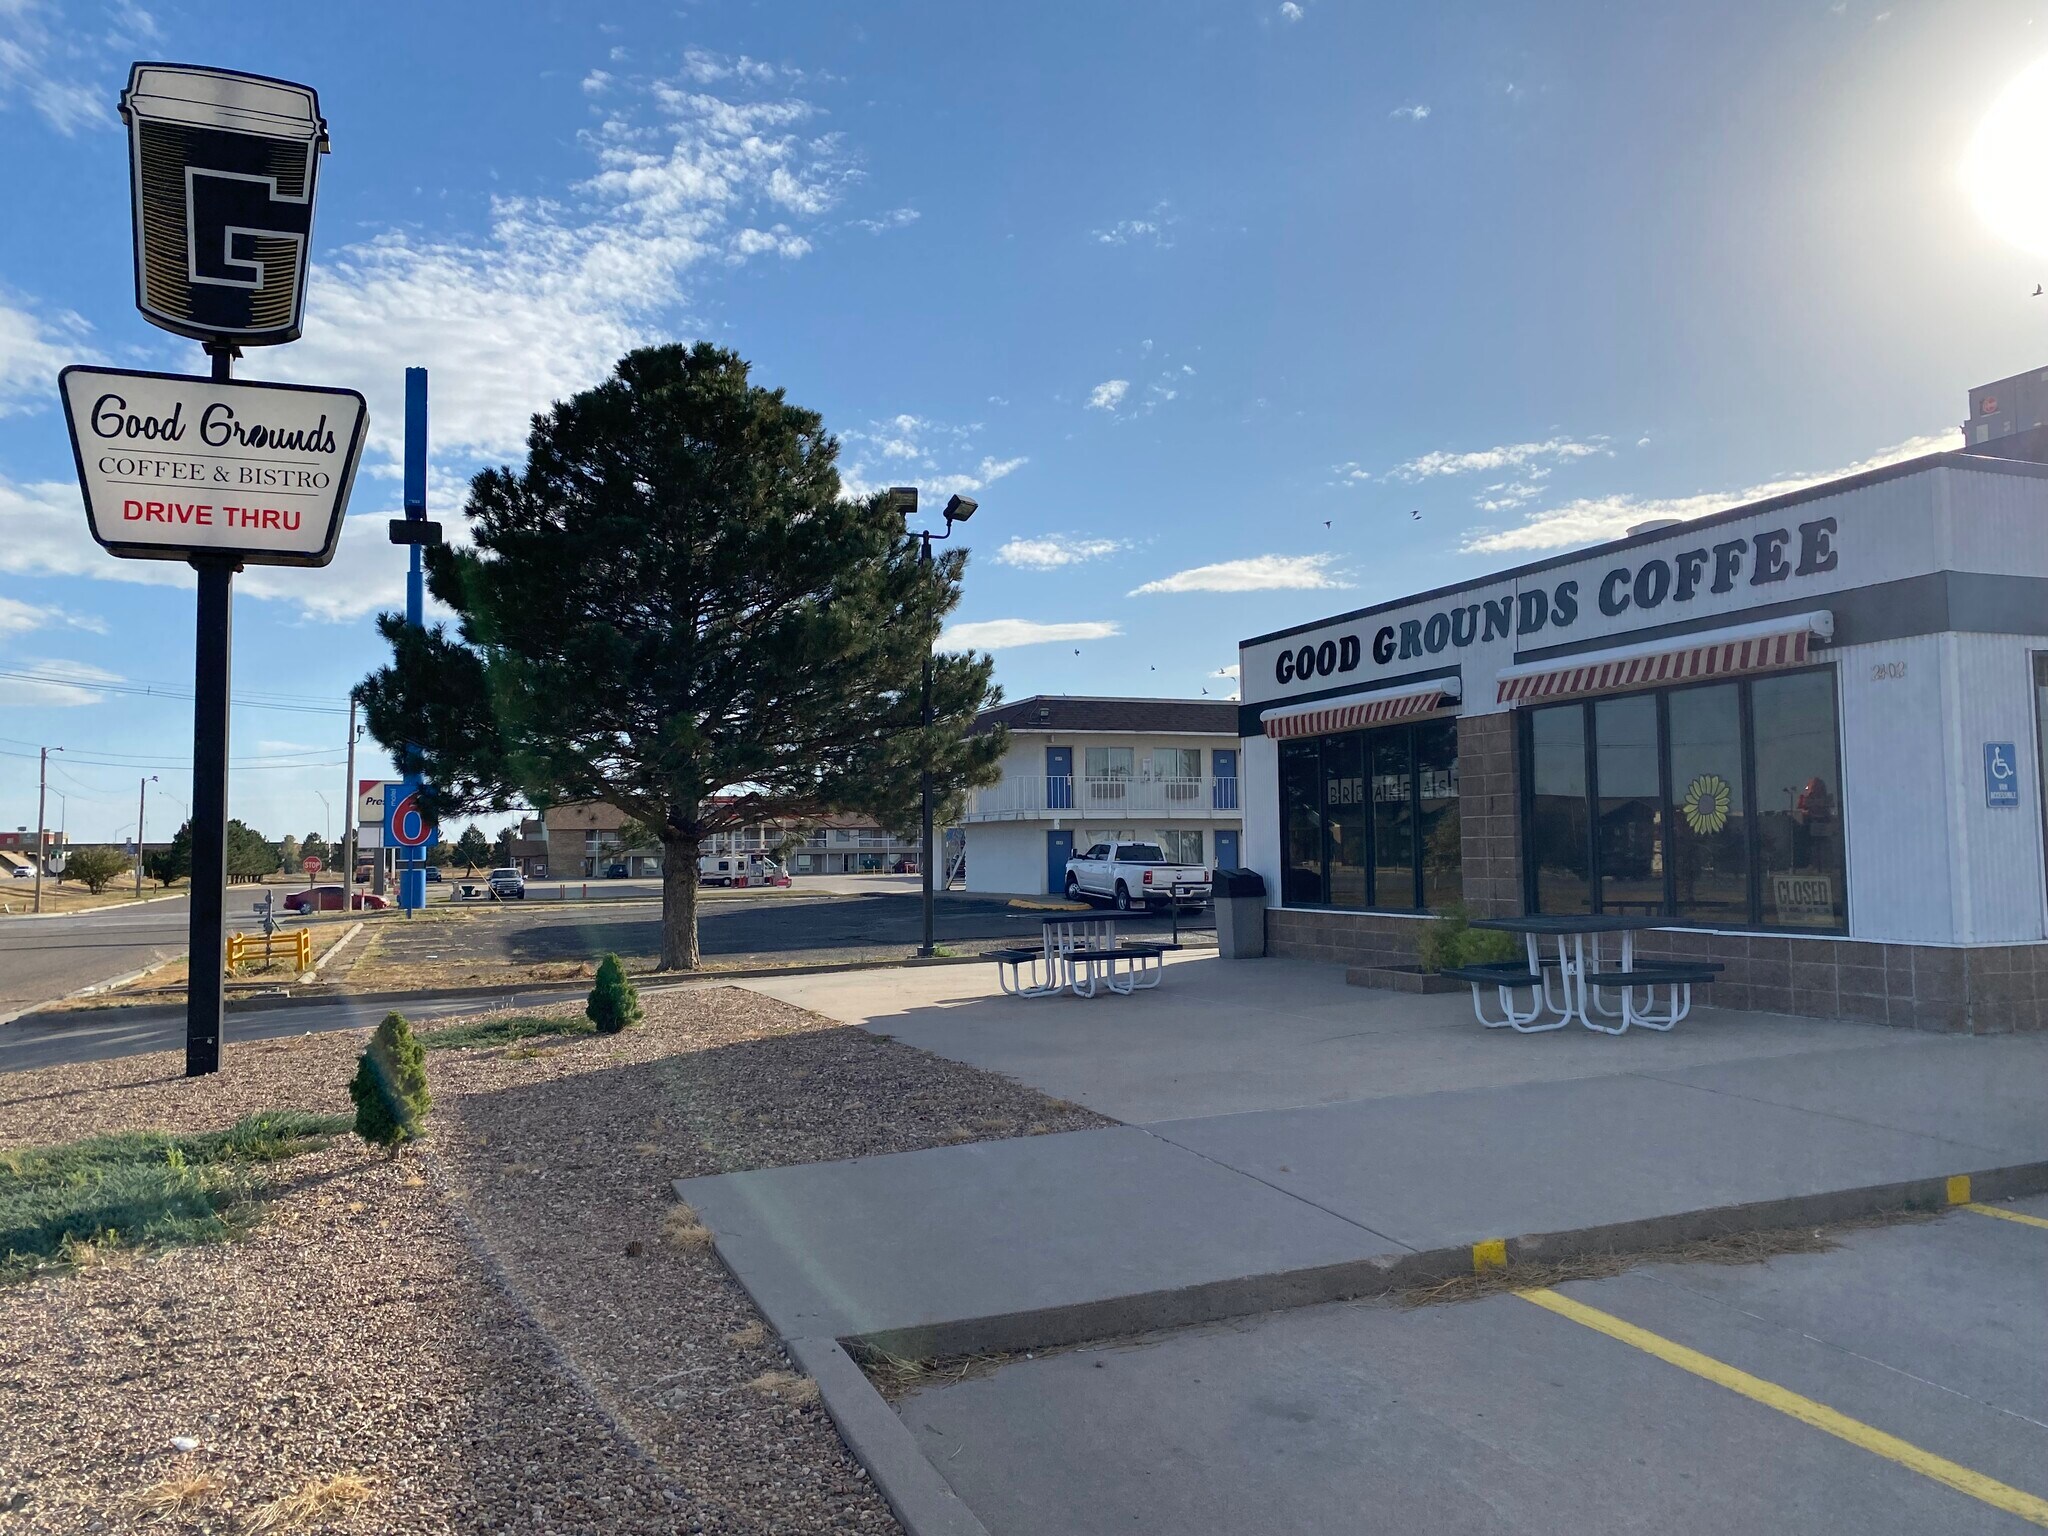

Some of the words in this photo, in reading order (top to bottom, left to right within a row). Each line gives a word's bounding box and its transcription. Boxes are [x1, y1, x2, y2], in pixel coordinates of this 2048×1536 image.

[184, 165, 309, 290] G
[91, 393, 187, 442] Good
[200, 402, 337, 455] Grounds
[98, 456, 206, 482] COFFEE
[213, 465, 231, 483] &
[239, 465, 331, 490] BISTRO
[123, 500, 214, 526] DRIVE
[222, 506, 302, 532] THRU
[1275, 634, 1362, 685] GOOD
[1372, 580, 1580, 665] GROUNDS
[1598, 516, 1839, 617] COFFEE
[304, 861, 321, 869] STOP
[1777, 880, 1829, 906] CLOSED
